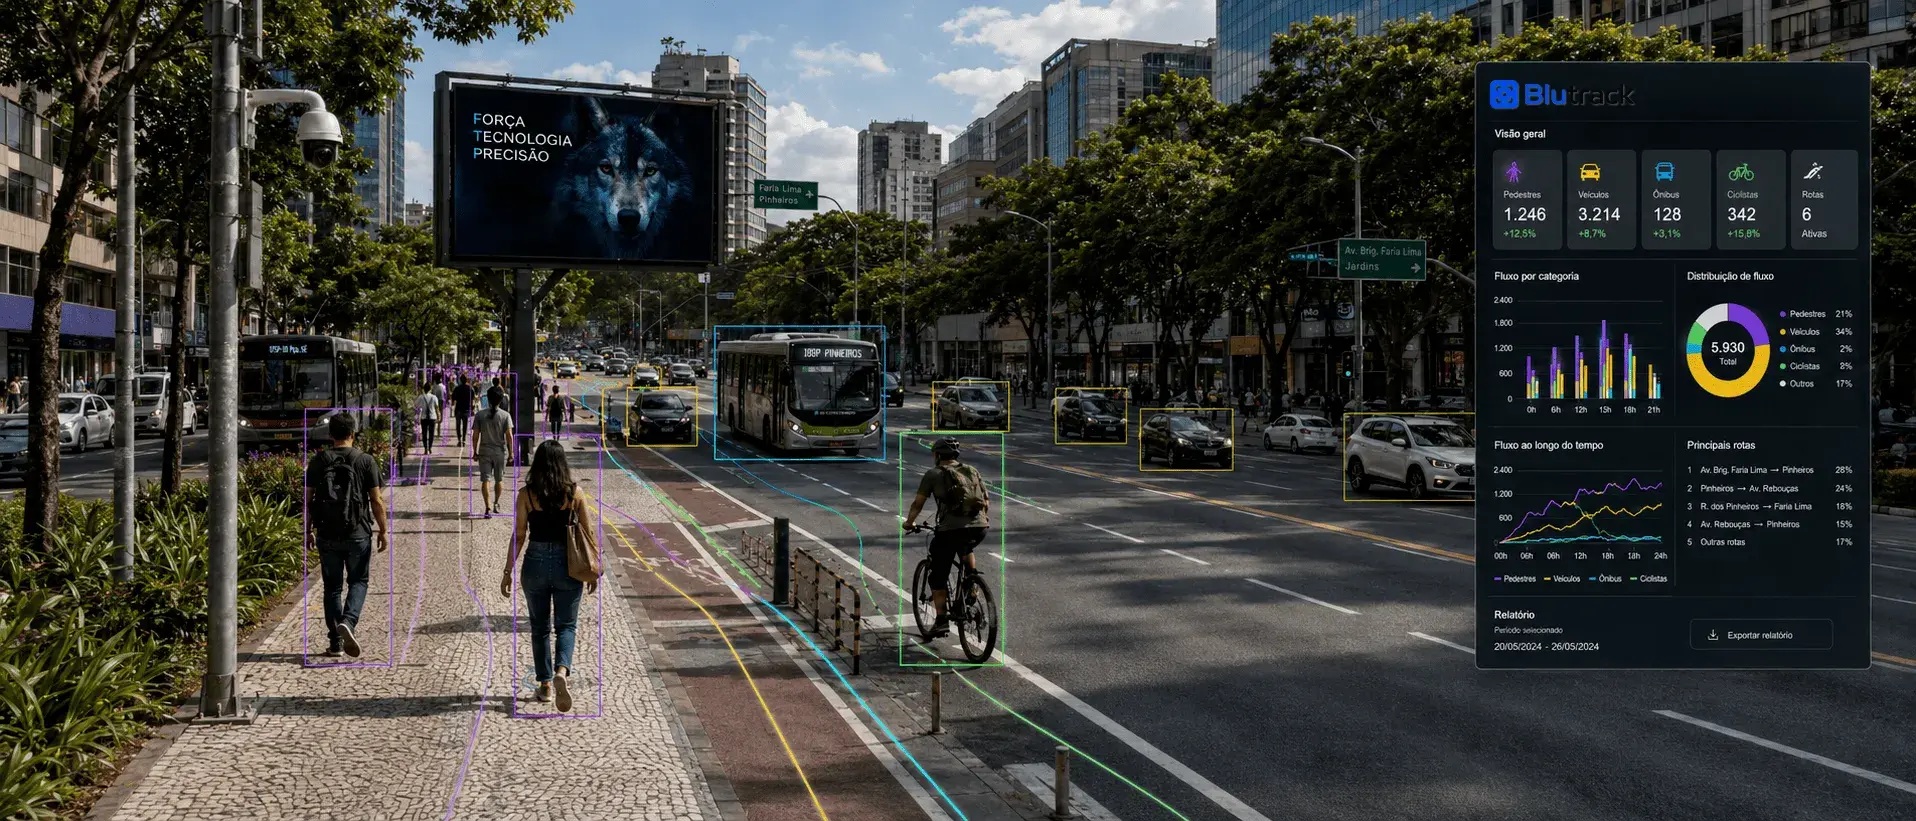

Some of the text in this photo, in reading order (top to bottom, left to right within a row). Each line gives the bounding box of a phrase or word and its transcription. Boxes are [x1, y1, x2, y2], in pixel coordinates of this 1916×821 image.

[473, 112, 526, 129] FORÇA
[472, 130, 573, 147] TECNOLOGIA
[473, 147, 550, 163] PRECISÃO
[759, 183, 802, 194] Faria Lima
[759, 195, 799, 205] Pinheiros
[1344, 246, 1422, 258] Av. Brig. Faria Lima
[1344, 262, 1380, 271] Jardins
[824, 349, 862, 359] PINHEIROS
